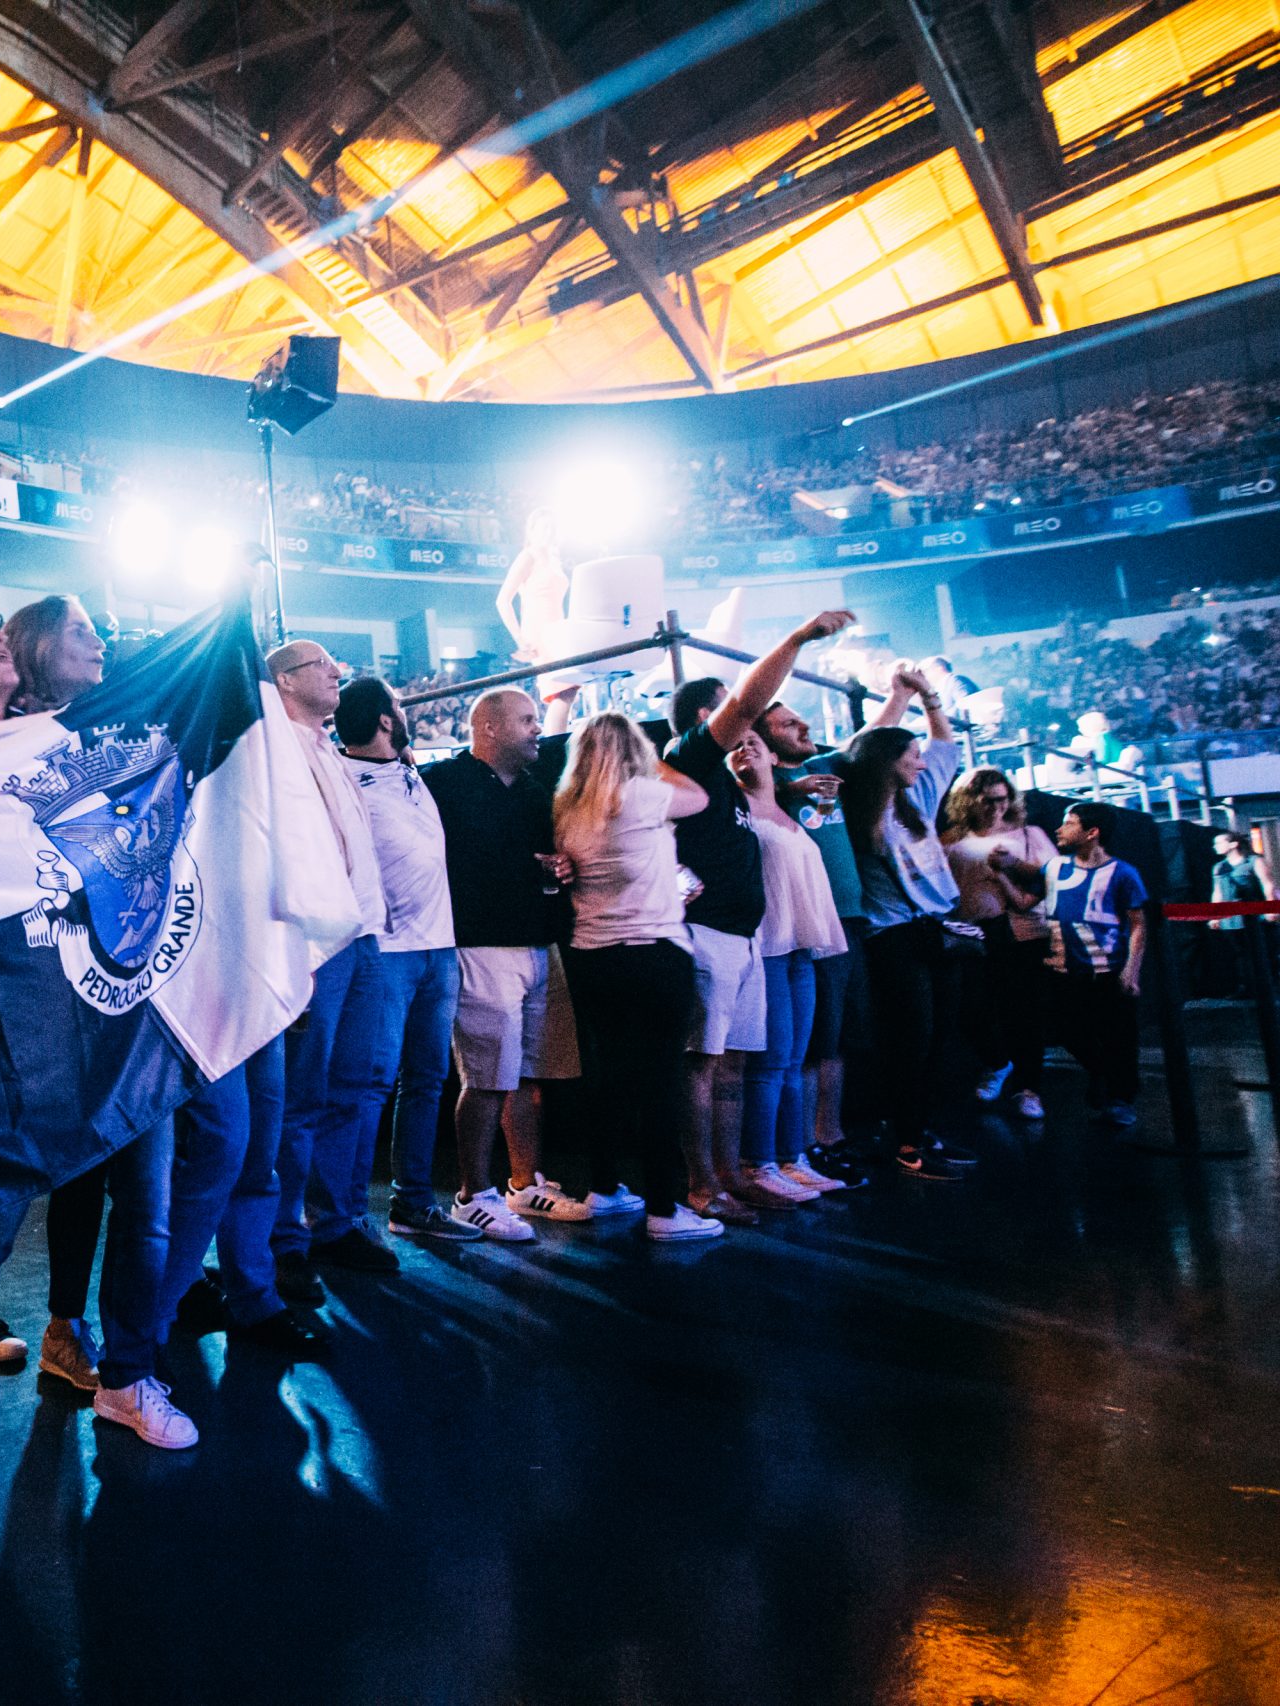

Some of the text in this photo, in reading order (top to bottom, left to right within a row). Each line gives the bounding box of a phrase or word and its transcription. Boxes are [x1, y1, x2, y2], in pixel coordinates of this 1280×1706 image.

[1219, 478, 1276, 501] MEO
[55, 502, 93, 522] MEO
[1112, 500, 1163, 519] MEO
[1013, 517, 1061, 535] MEO
[922, 530, 967, 547] MEO
[342, 543, 376, 559] MEO
[410, 549, 444, 564] MEO
[837, 541, 879, 557] MEO
[152, 882, 195, 973] GRANDE
